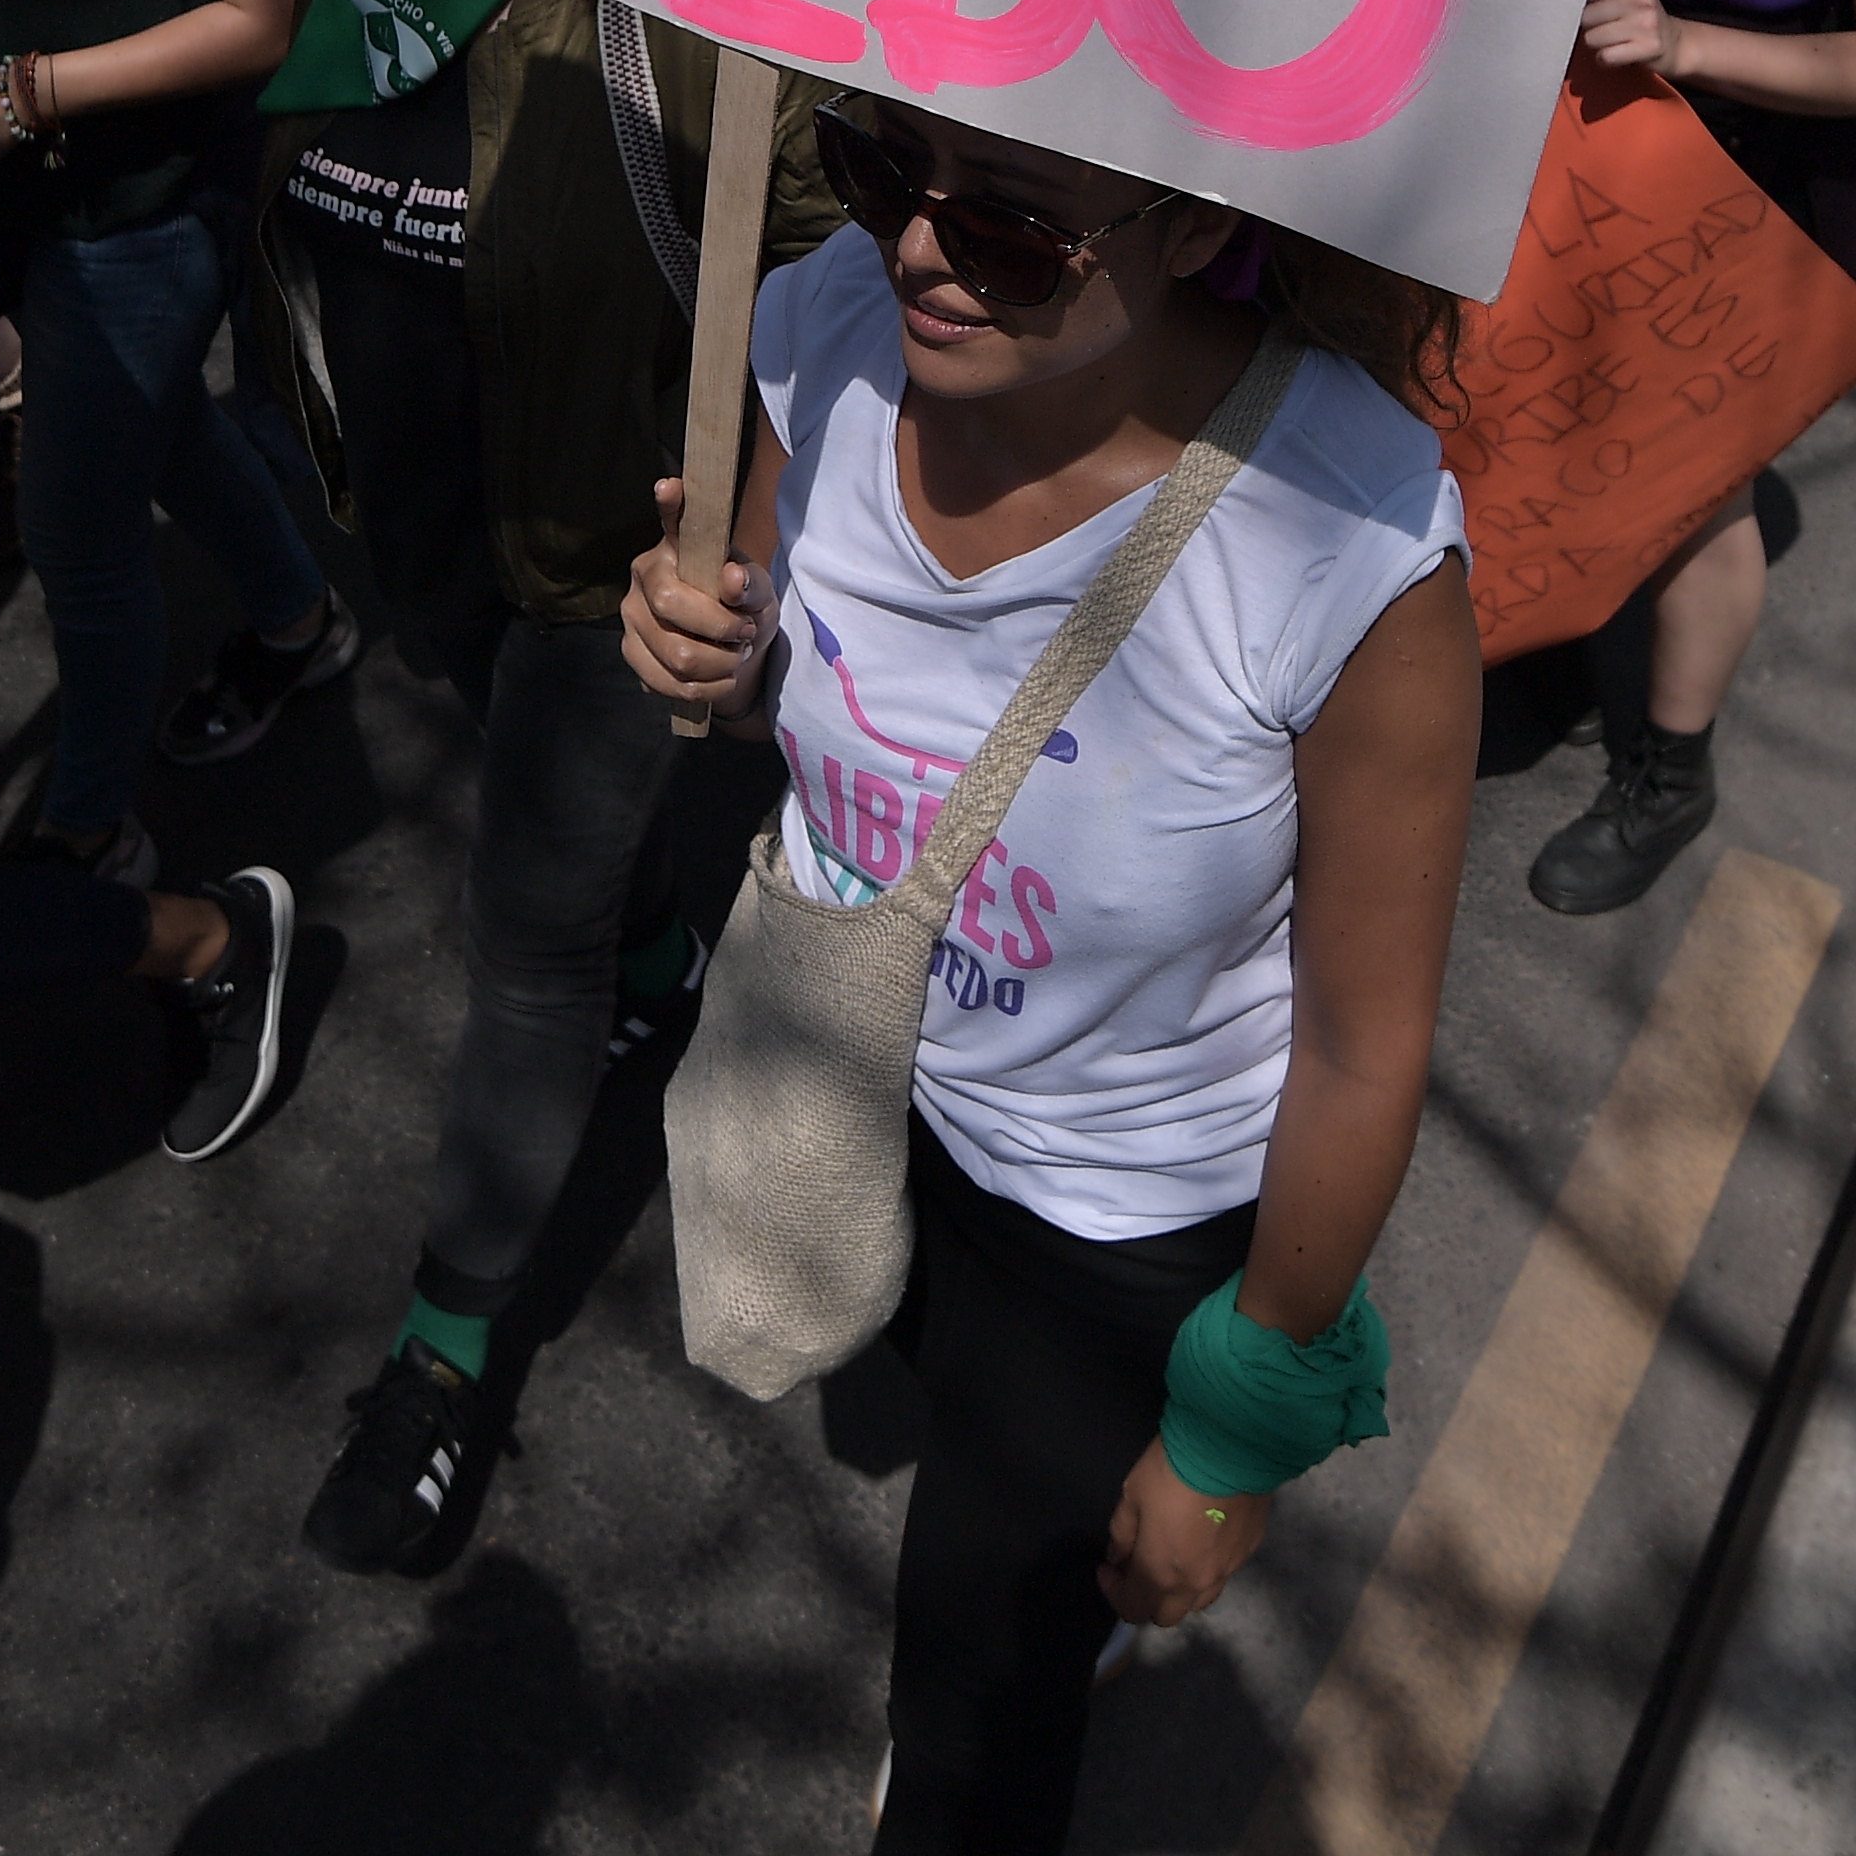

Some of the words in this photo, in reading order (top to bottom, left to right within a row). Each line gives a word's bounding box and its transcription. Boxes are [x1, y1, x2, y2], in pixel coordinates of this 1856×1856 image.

[287, 175, 384, 228] siempre
[299, 146, 402, 199] siempre
[1648, 277, 1738, 350] ES
[1672, 333, 1781, 418] DE
